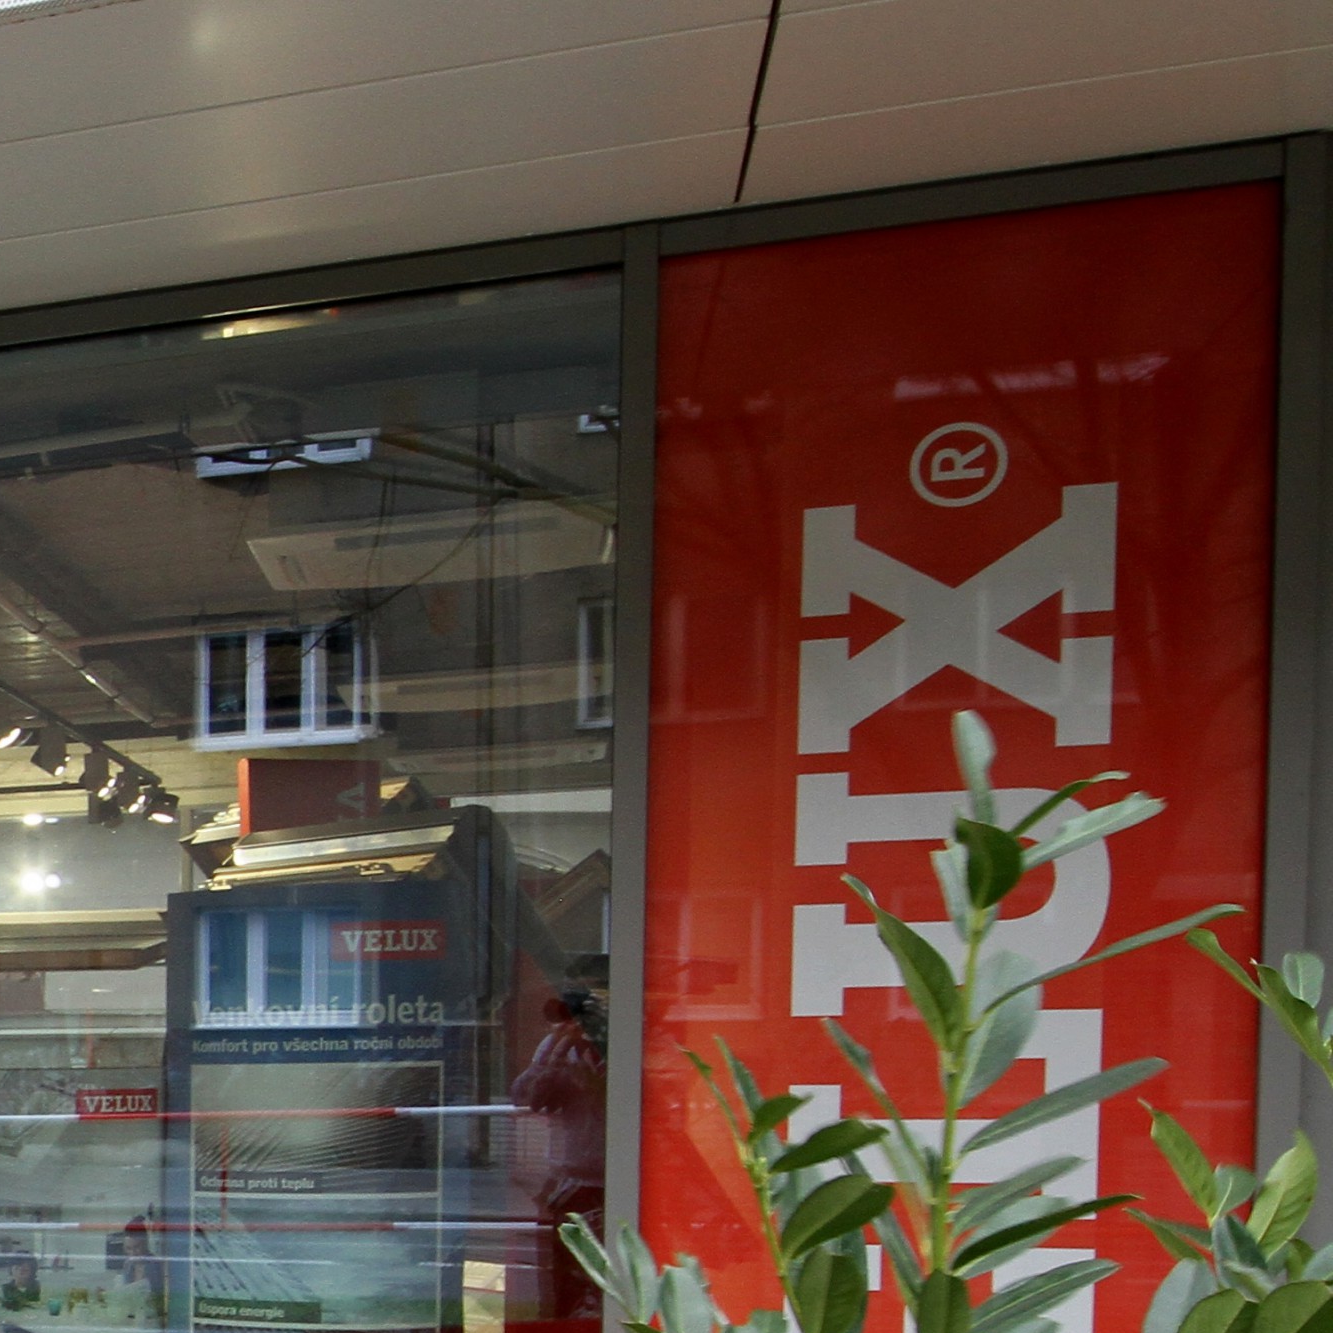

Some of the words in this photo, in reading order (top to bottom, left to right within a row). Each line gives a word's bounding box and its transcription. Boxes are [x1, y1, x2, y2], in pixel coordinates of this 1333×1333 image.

[341, 928, 439, 953] VELUX
[353, 994, 445, 1025] roleta
[192, 1038, 249, 1054] Komfort
[252, 1040, 279, 1055] pro
[282, 1037, 350, 1053] všechna
[83, 1095, 152, 1113] VELUX
